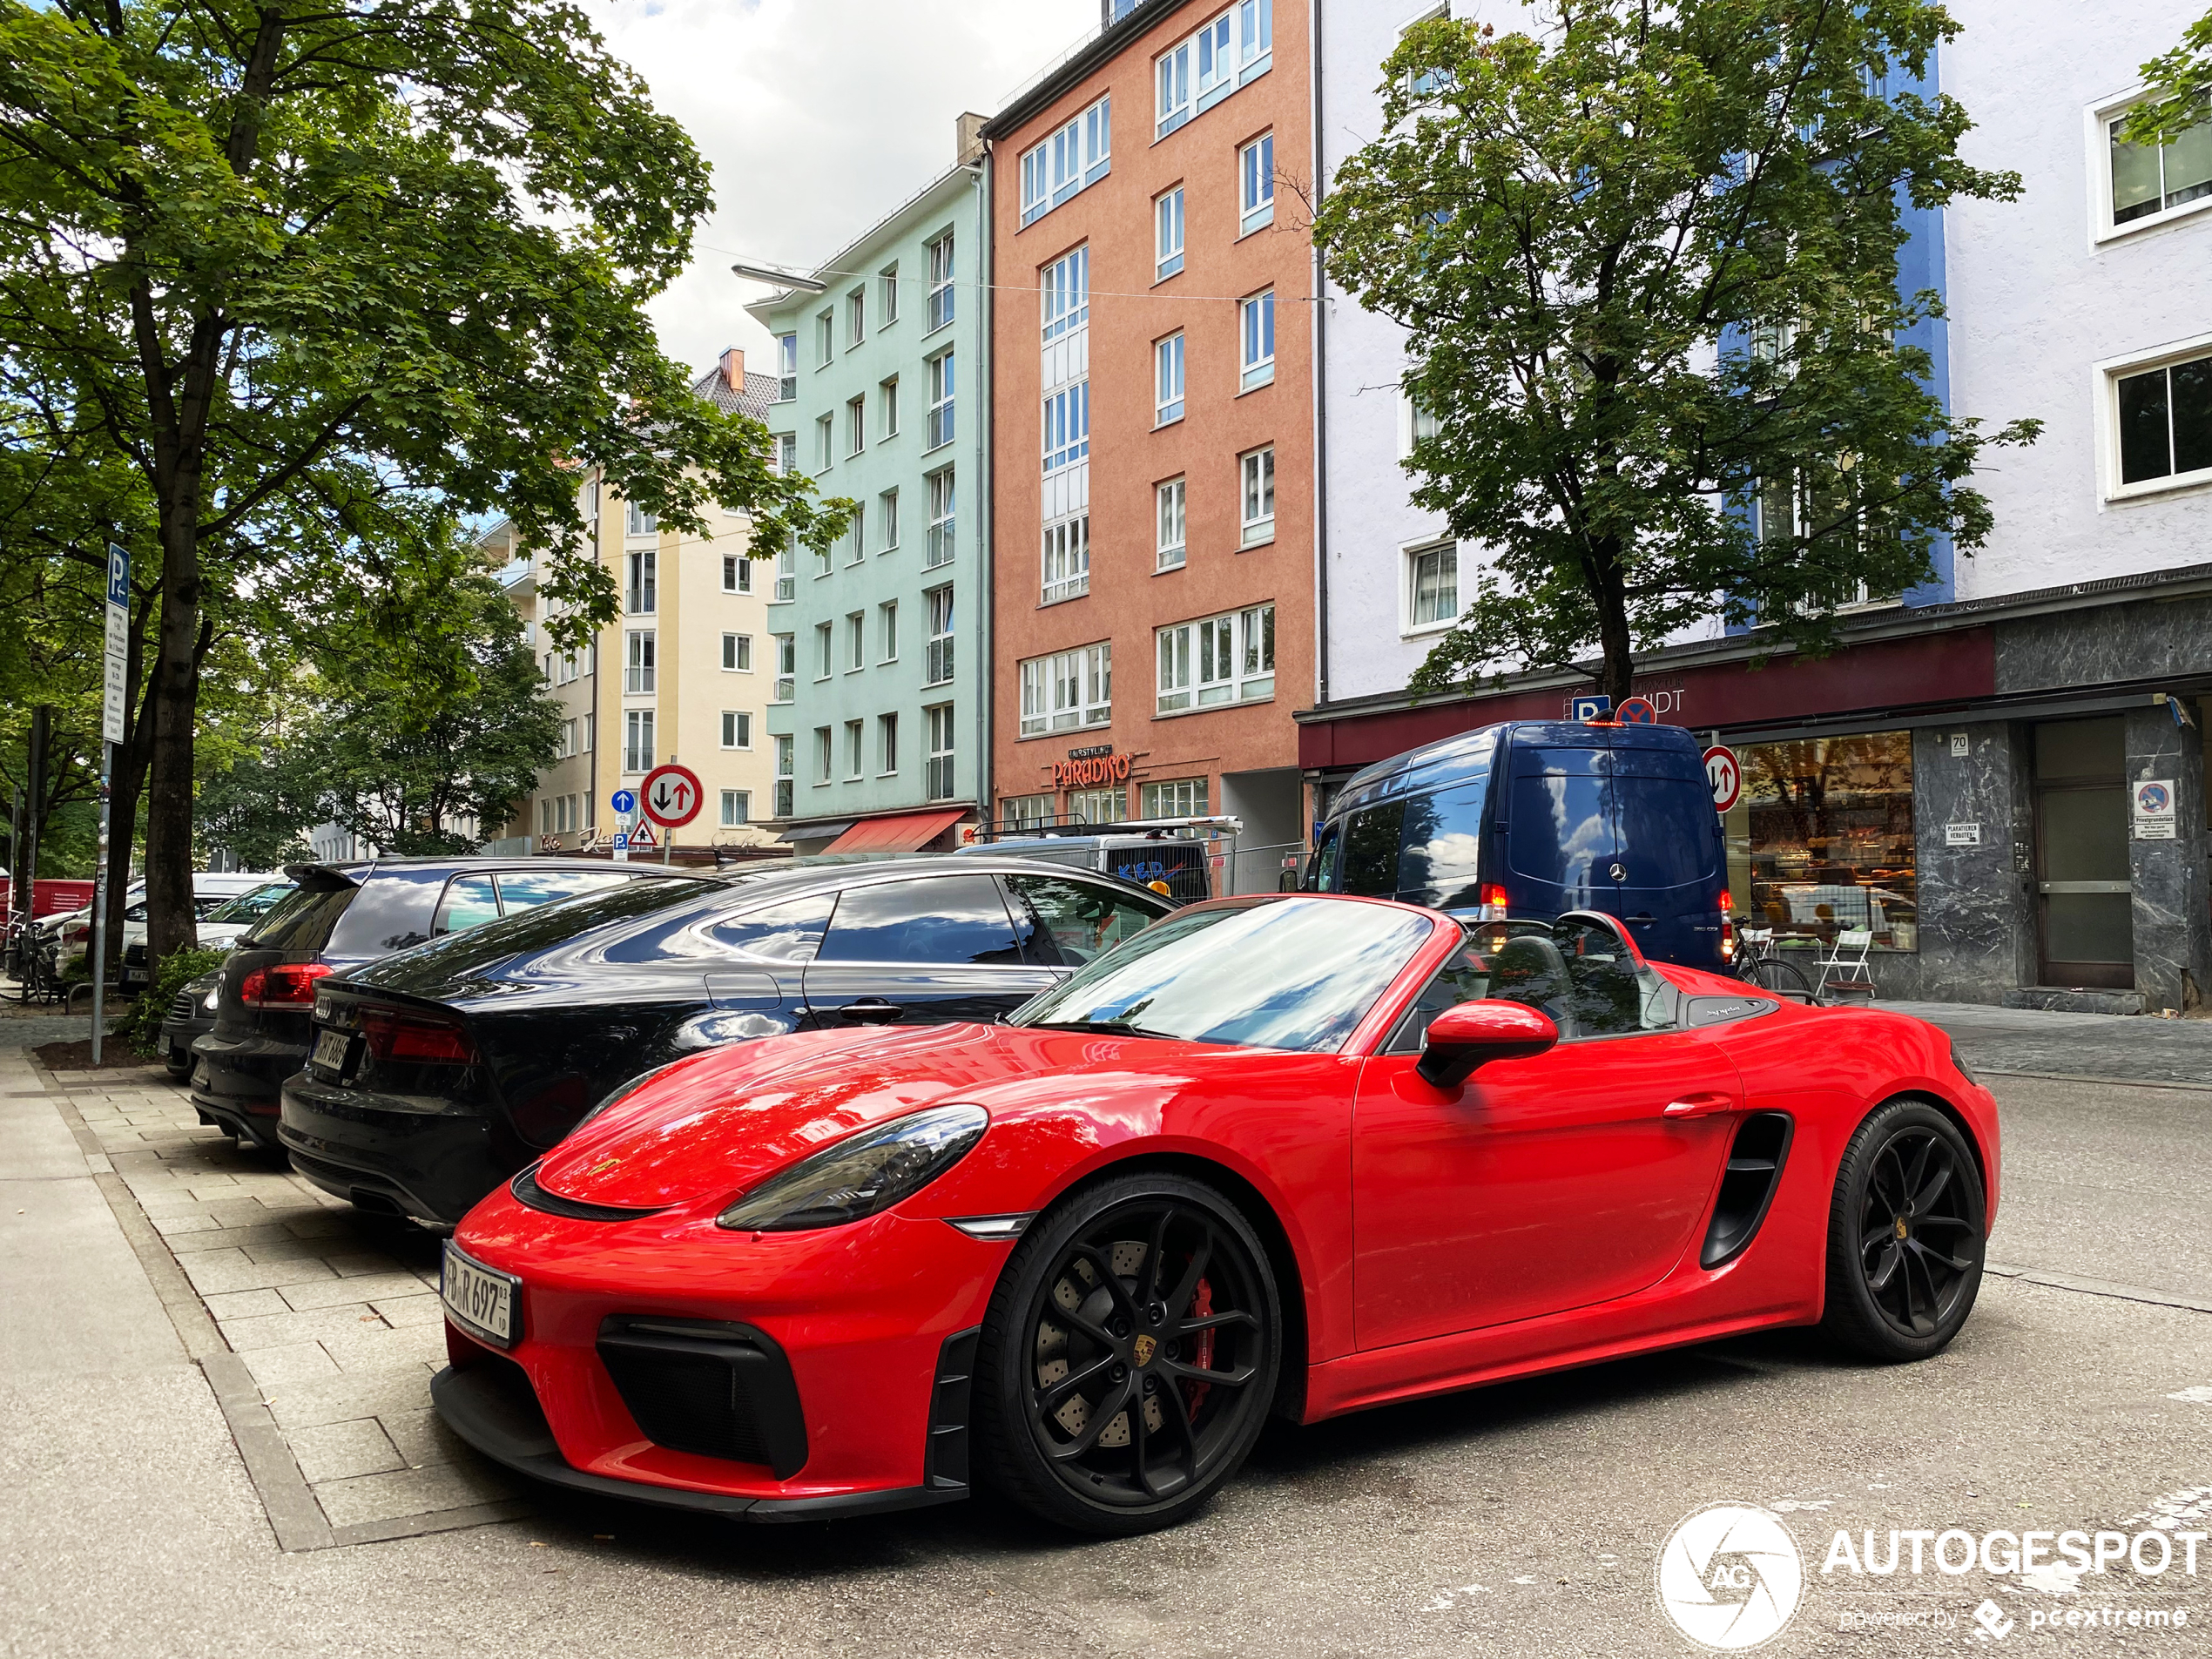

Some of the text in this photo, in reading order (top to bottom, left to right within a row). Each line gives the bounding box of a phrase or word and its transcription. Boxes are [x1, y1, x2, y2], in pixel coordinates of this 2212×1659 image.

[111, 552, 124, 595] P
[1953, 737, 1966, 748] 70
[1052, 754, 1130, 790] PARADISO
[616, 835, 624, 848] P
[463, 1270, 470, 1312] R
[473, 1277, 498, 1325] 697
